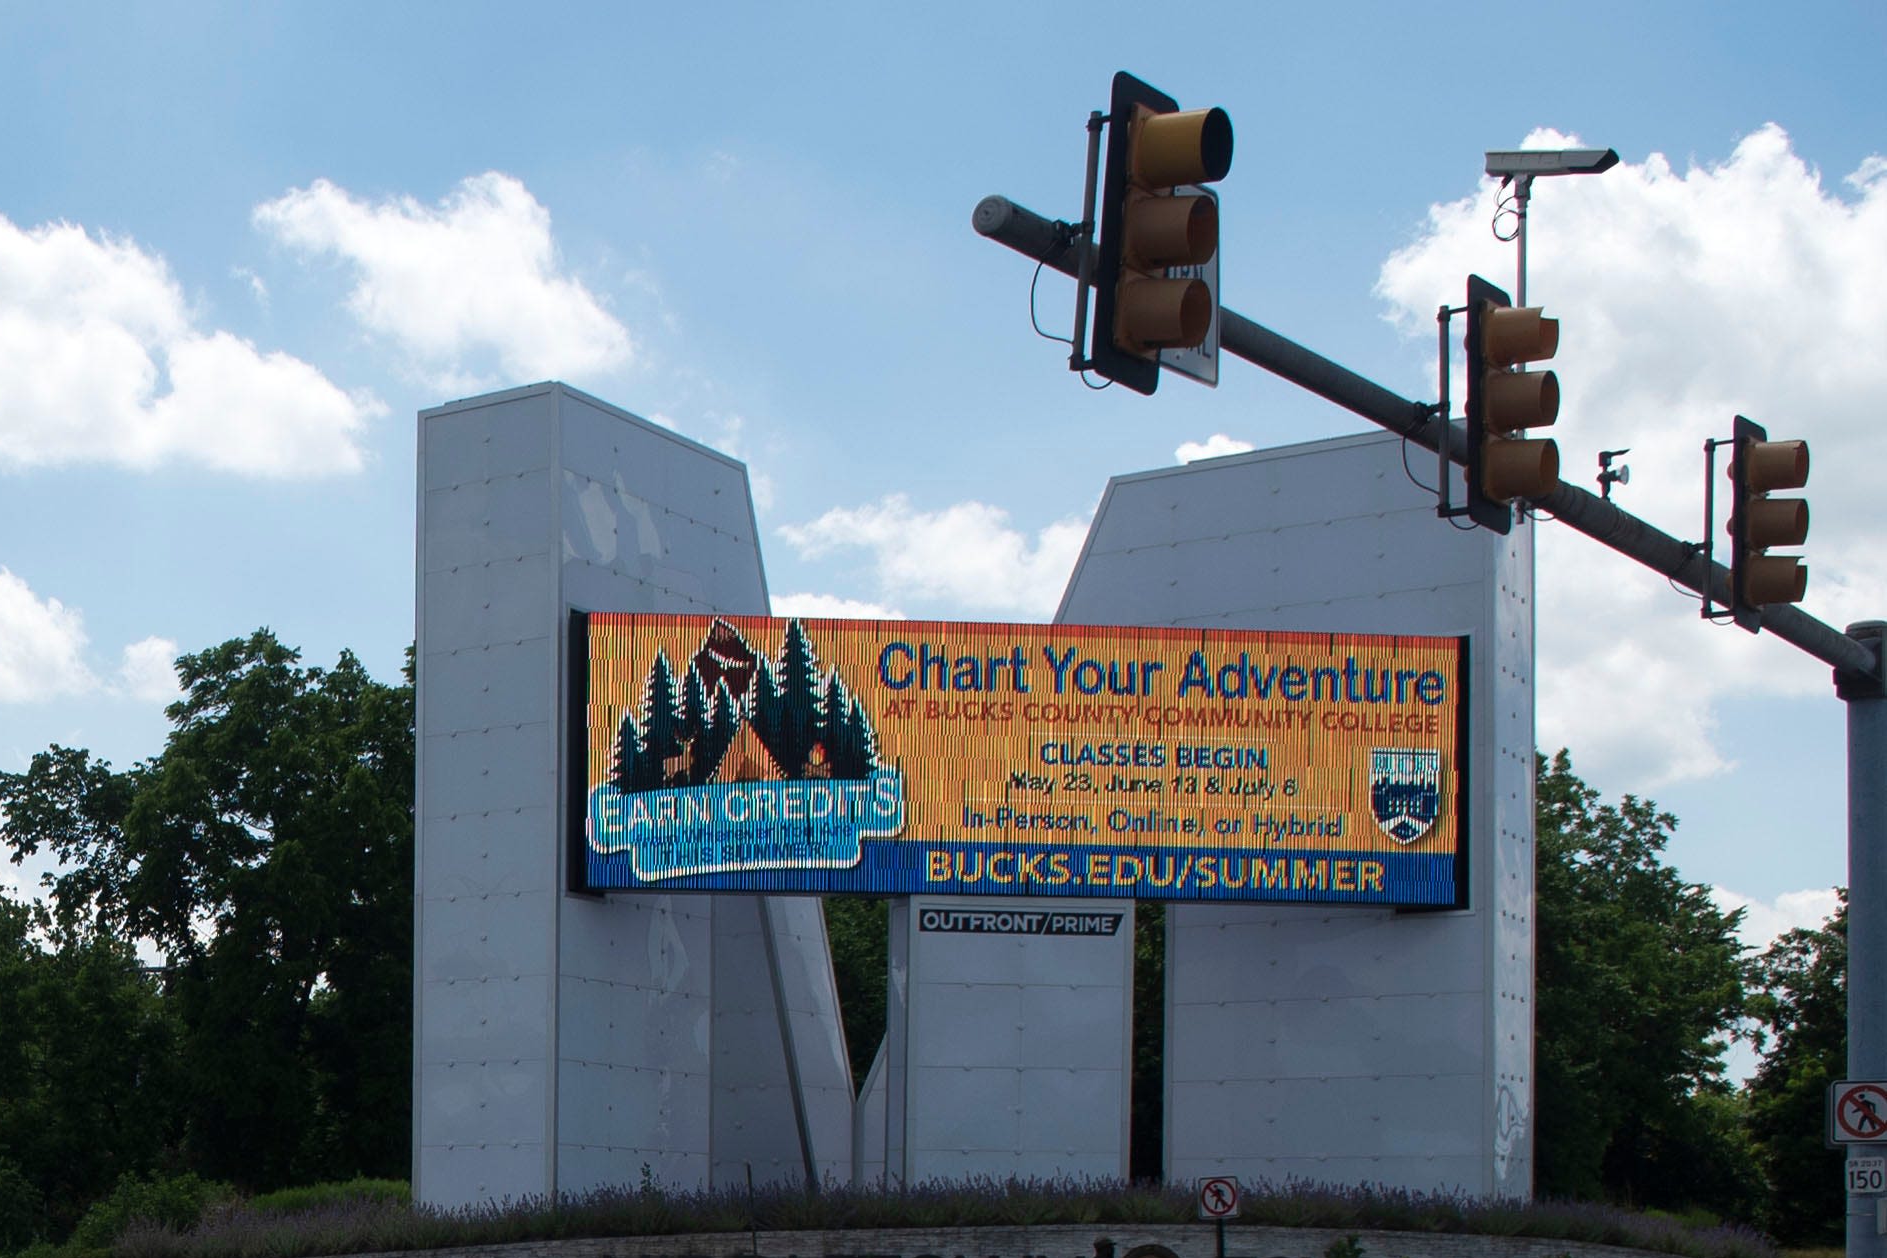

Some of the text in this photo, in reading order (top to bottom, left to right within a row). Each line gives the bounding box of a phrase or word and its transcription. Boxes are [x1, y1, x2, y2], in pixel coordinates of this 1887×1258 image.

[878, 641, 1446, 705] Chart Your Adventure
[883, 700, 1440, 734] AT BUCKS COUNTY COMMUNITY COLLEGE
[1040, 741, 1268, 769] CLASSES BEGIN
[1009, 771, 1055, 795] May
[1062, 772, 1098, 795] 23,
[1105, 773, 1162, 793] June
[1170, 776, 1199, 794] 13
[1205, 777, 1222, 795] &
[1229, 777, 1278, 801] July
[600, 778, 897, 832] EARN CREDITS
[964, 806, 1344, 842] In-Person, Online, or Hybrid
[925, 849, 1385, 893] BUCKS.EDU/SUMMER
[1849, 1170, 1882, 1189] 150
